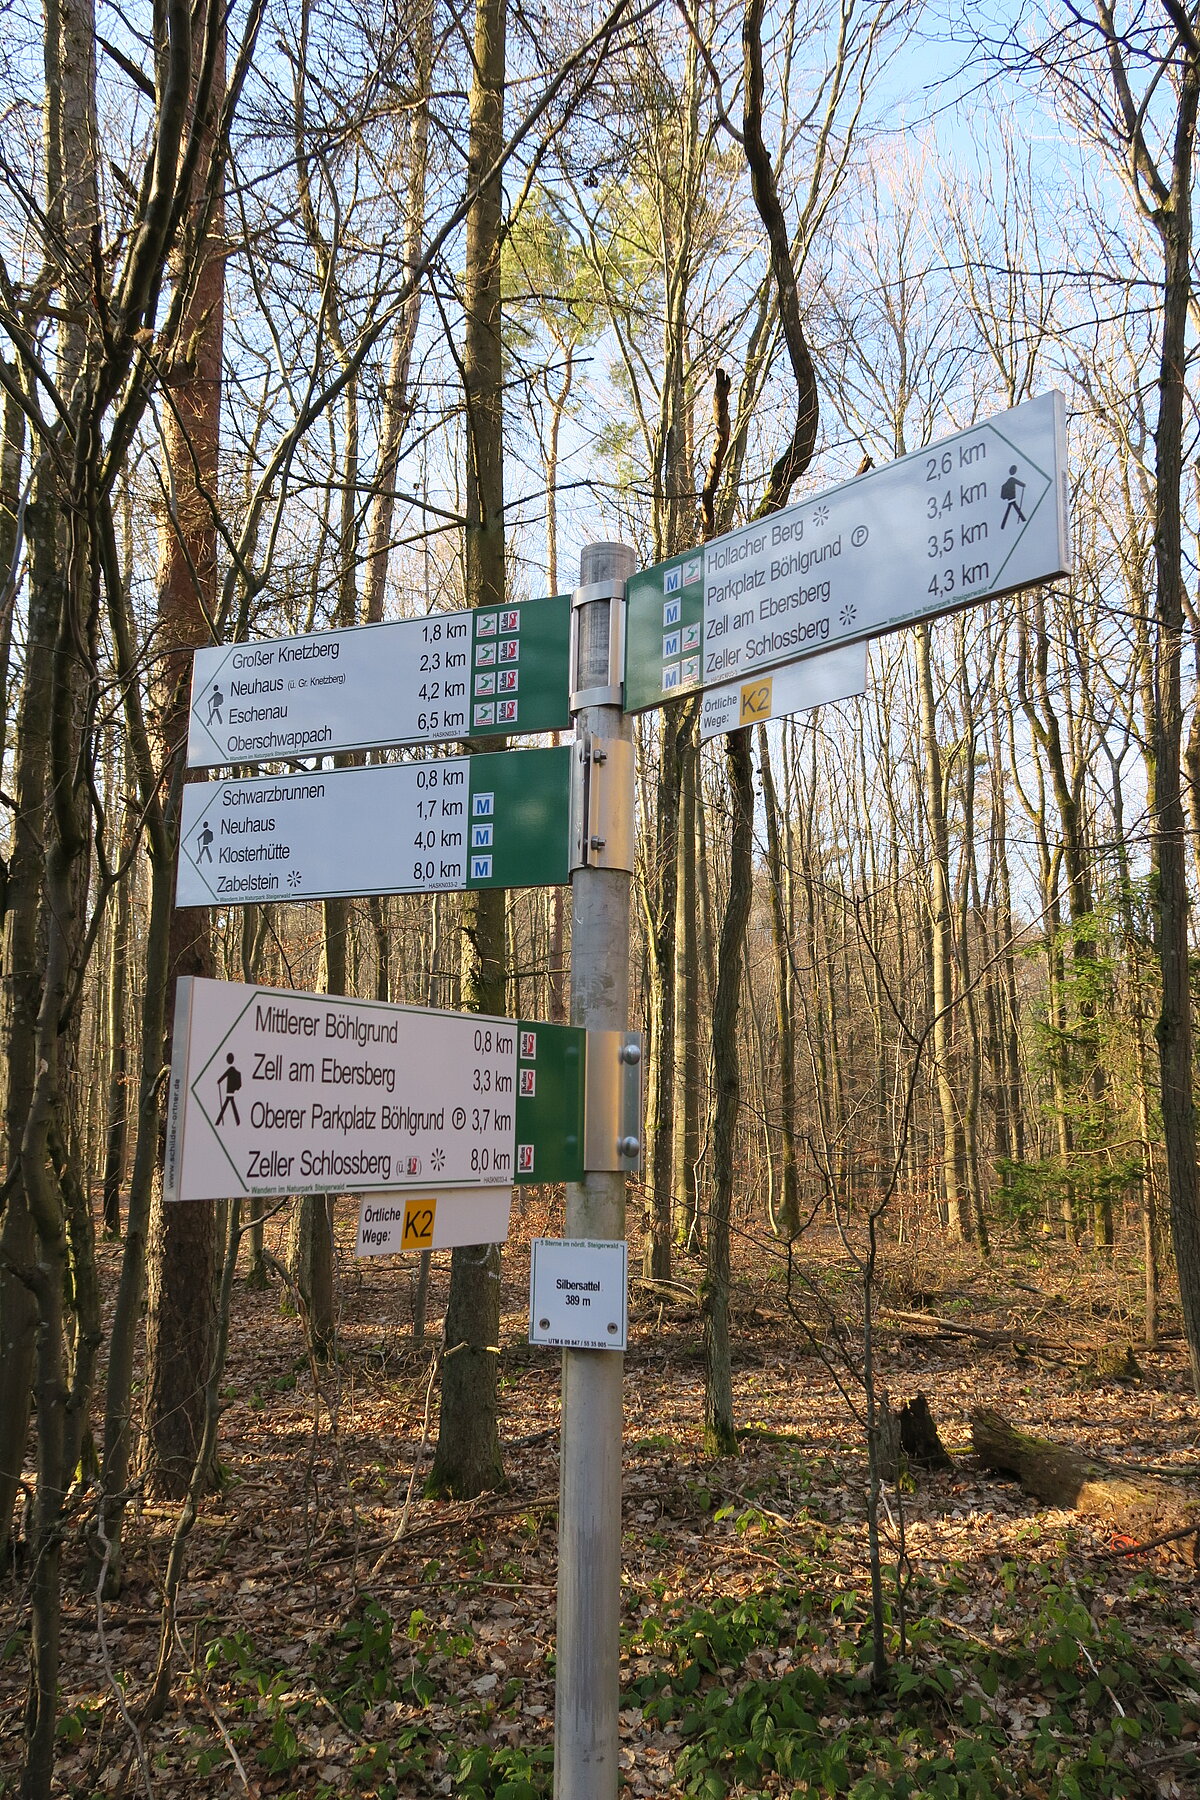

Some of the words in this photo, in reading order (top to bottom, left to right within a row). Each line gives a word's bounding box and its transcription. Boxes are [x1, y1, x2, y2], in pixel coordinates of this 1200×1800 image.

[926, 452, 952, 482] 2,6
[959, 442, 986, 468] km
[927, 490, 953, 521] 3,4
[960, 481, 987, 507] km
[707, 535, 767, 573] Hollacher
[771, 519, 804, 547] Berg
[927, 530, 954, 558] 3,5
[961, 521, 988, 547] km
[707, 571, 766, 606] Parkplatz
[770, 535, 842, 582] Böhlgrund
[927, 570, 954, 598] 4,3
[962, 561, 989, 587] km
[952, 586, 988, 603] Steigerwald
[706, 615, 729, 640] Zell
[733, 609, 754, 628] am
[760, 580, 831, 621] Ebersberg
[422, 624, 442, 644] 1,8
[446, 622, 467, 639] km
[706, 647, 742, 674] Zeller
[746, 617, 830, 660] Schlossberg
[232, 650, 275, 670] Großer
[278, 642, 340, 663] Knetzberg
[419, 653, 441, 673] 2,3
[445, 651, 466, 668] km
[230, 678, 284, 697] Neuhaus
[298, 679, 308, 688] Gr.
[310, 673, 346, 687] Knetzberg)
[418, 682, 439, 702] 4,2
[444, 681, 465, 697] km
[704, 695, 737, 713] Örtliche
[741, 688, 770, 716] K2
[228, 706, 288, 725] Eschenau
[417, 711, 439, 732] 6,5
[444, 711, 464, 727] km
[703, 713, 729, 728] Wege:
[227, 725, 332, 752] Oberschwappach
[416, 770, 438, 790] 0,8
[443, 769, 464, 786] km
[222, 784, 325, 806] Schwarzbrunnen
[416, 800, 437, 820] 1,7
[442, 799, 463, 816] km
[220, 817, 275, 835] Neuhaus
[414, 830, 436, 851] 4,0
[441, 830, 462, 847] km
[218, 843, 290, 864] Klosterhütte
[216, 873, 279, 893] Zabelstein
[413, 862, 435, 881] 8,0
[440, 861, 461, 877] km
[255, 1005, 320, 1037] Mittlerer
[325, 1013, 398, 1047] Böhlgrund
[474, 1030, 492, 1055] 0,8
[495, 1032, 513, 1054] km
[252, 1052, 282, 1081] Zell
[289, 1062, 314, 1083] am
[321, 1058, 396, 1093] Ebersberg
[473, 1069, 491, 1094] 3,3
[495, 1071, 512, 1092] km
[250, 1101, 306, 1129] Oberer
[311, 1103, 376, 1135] Parkplatz
[381, 1105, 444, 1136] Böhlgrund
[472, 1109, 490, 1134] 3,7
[494, 1110, 511, 1131] km
[168, 1079, 180, 1189] www.schilder-ortner.de
[246, 1150, 294, 1178] Zeller
[300, 1149, 391, 1180] Schlossberg
[470, 1149, 489, 1174] 8,0
[494, 1148, 510, 1171] km
[251, 1186, 276, 1195] Wandern
[278, 1185, 285, 1193] im
[286, 1184, 313, 1193] Naturpark
[315, 1183, 345, 1192] Steigerwald
[364, 1205, 401, 1223] Örtliche
[404, 1210, 433, 1239] K2
[362, 1228, 391, 1244] Wege:
[555, 1278, 601, 1292] Silbersattel
[565, 1295, 580, 1305] 389
[582, 1298, 591, 1306] m
